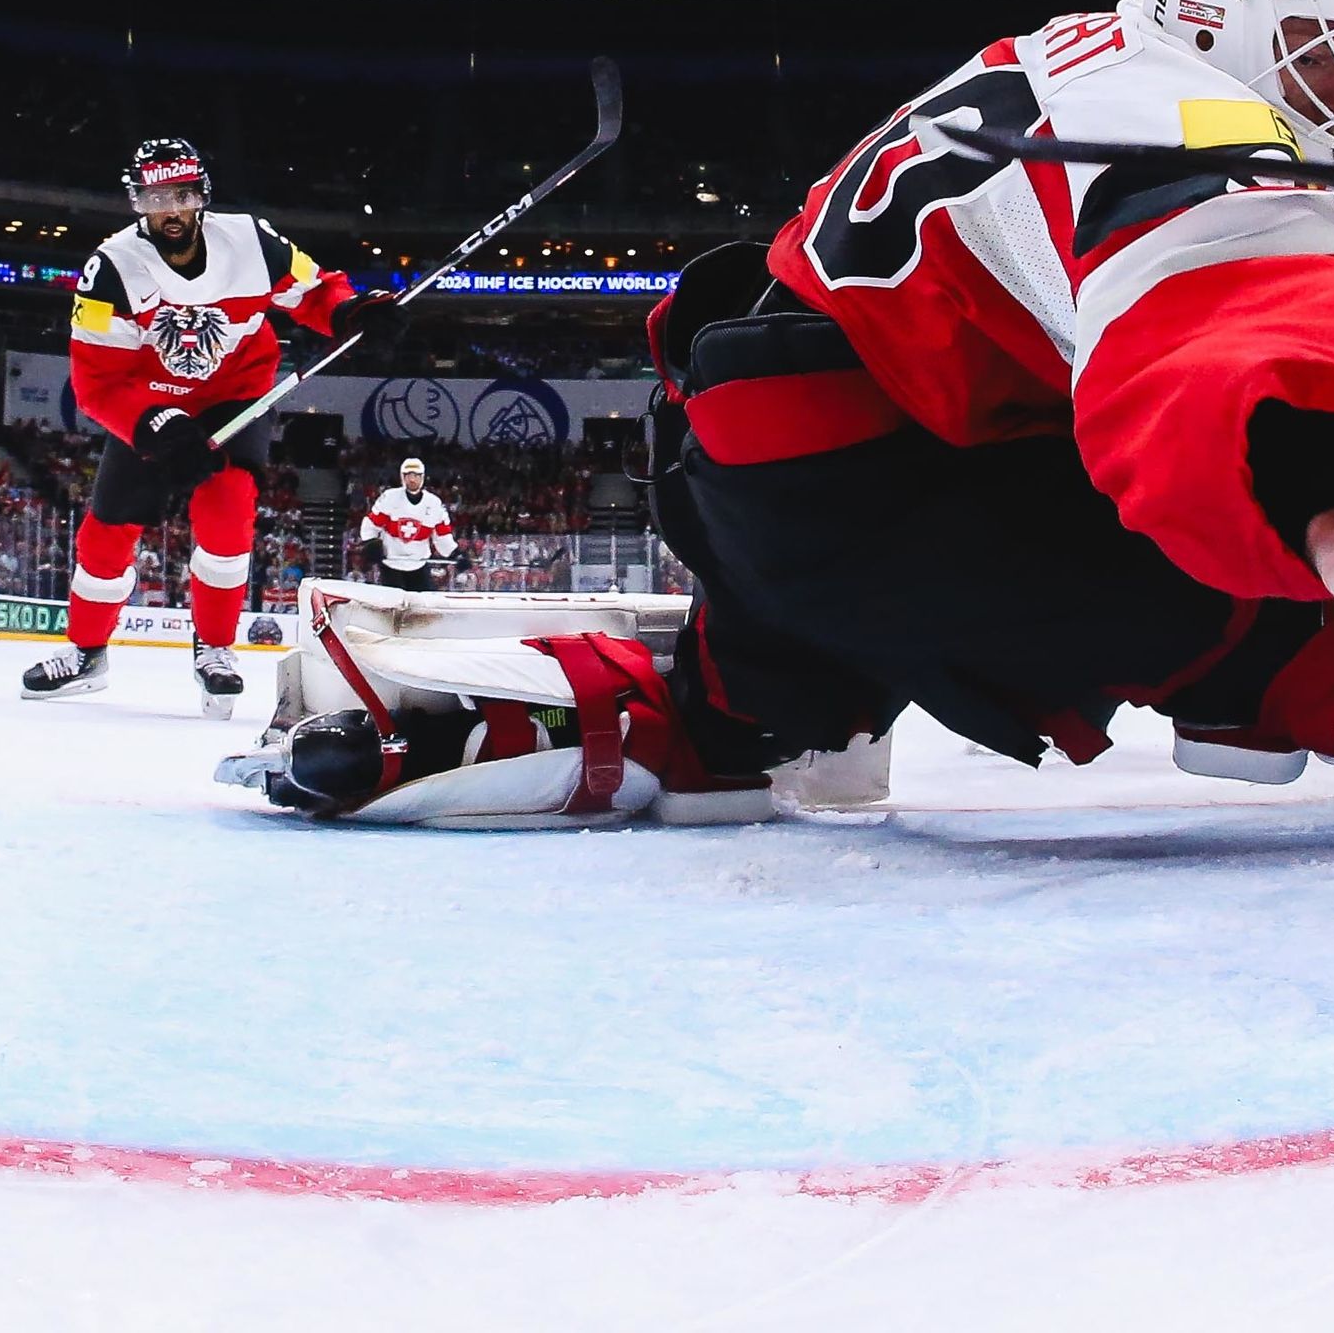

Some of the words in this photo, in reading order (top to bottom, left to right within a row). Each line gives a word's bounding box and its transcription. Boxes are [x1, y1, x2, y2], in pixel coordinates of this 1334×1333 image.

[460, 193, 534, 255] CCM
[436, 276, 471, 290] 2024
[474, 276, 505, 290] IIHF
[508, 276, 534, 290] ICE
[538, 276, 604, 290] HOCKEY
[608, 276, 667, 290] WORLD
[124, 617, 154, 632] APP
